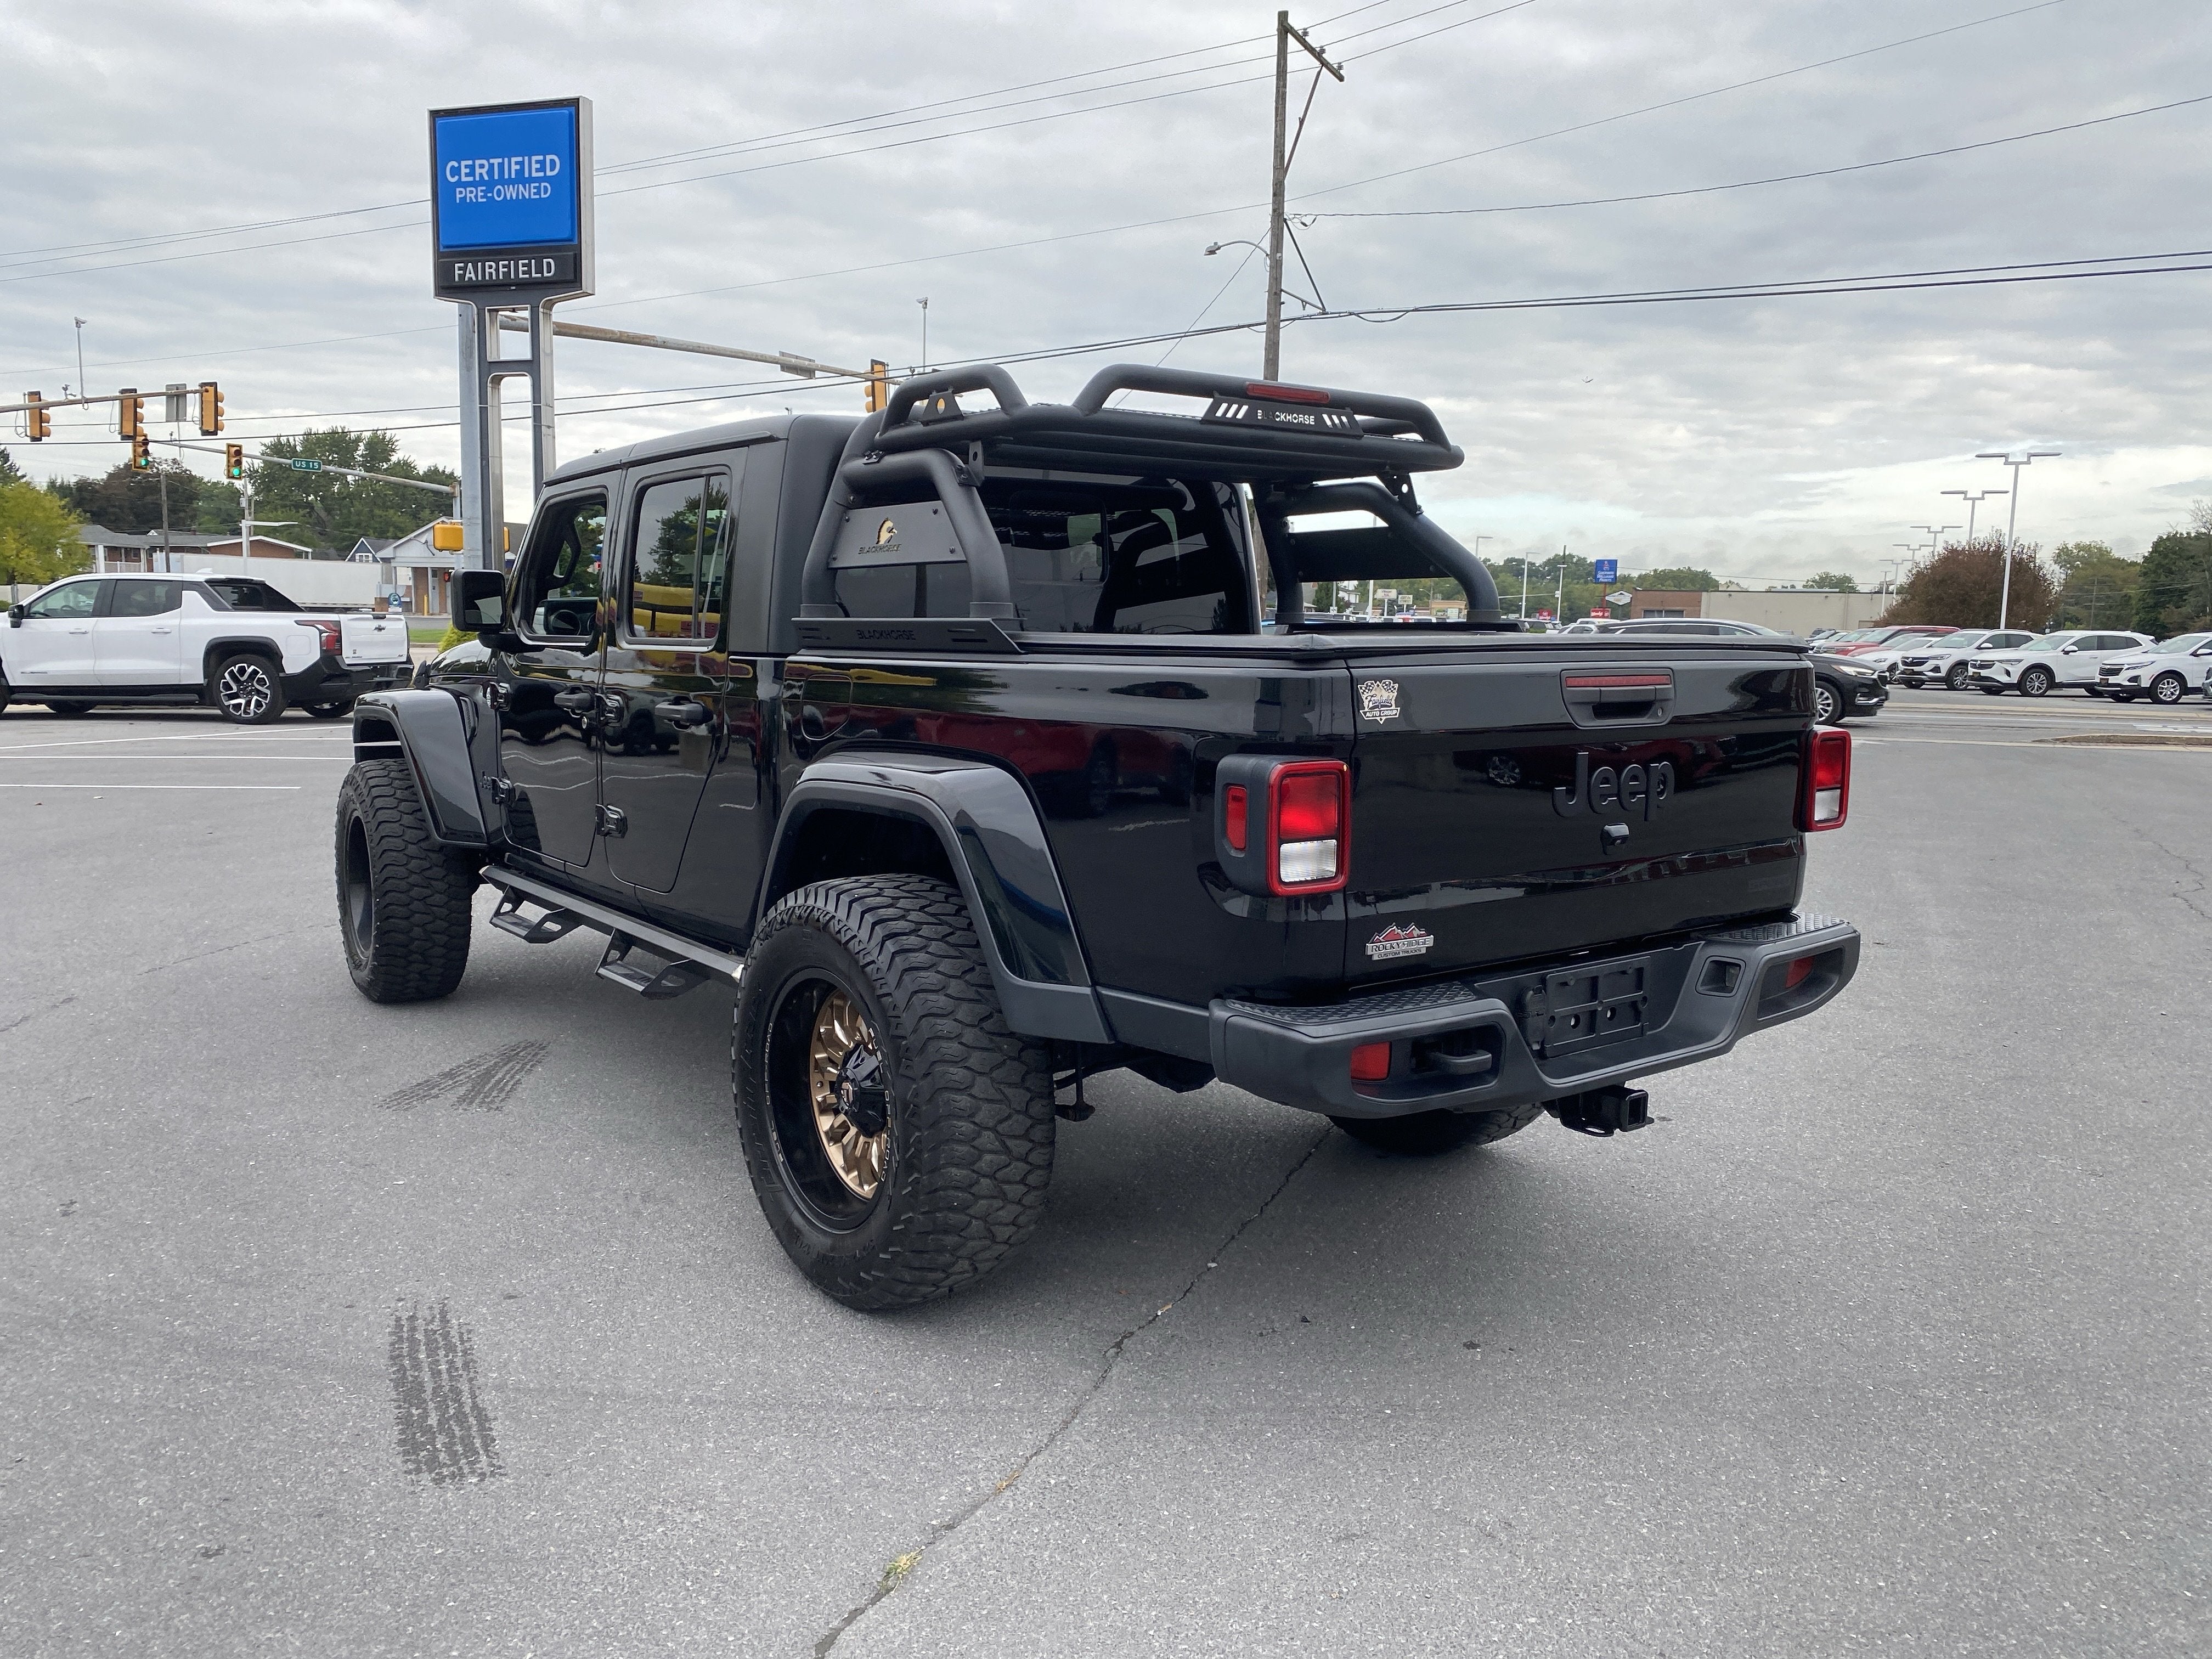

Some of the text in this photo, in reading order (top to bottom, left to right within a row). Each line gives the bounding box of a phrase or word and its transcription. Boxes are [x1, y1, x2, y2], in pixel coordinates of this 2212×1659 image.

[445, 154, 561, 183] CERTIFIED
[456, 182, 551, 204] PRE-OWNED
[454, 258, 555, 282] FAIRFIELD
[1257, 410, 1315, 425] BLACKHORSE
[857, 544, 902, 555] BLACKHORSE
[856, 629, 916, 641] BLACKHORSE
[1552, 751, 1675, 822] Jeep
